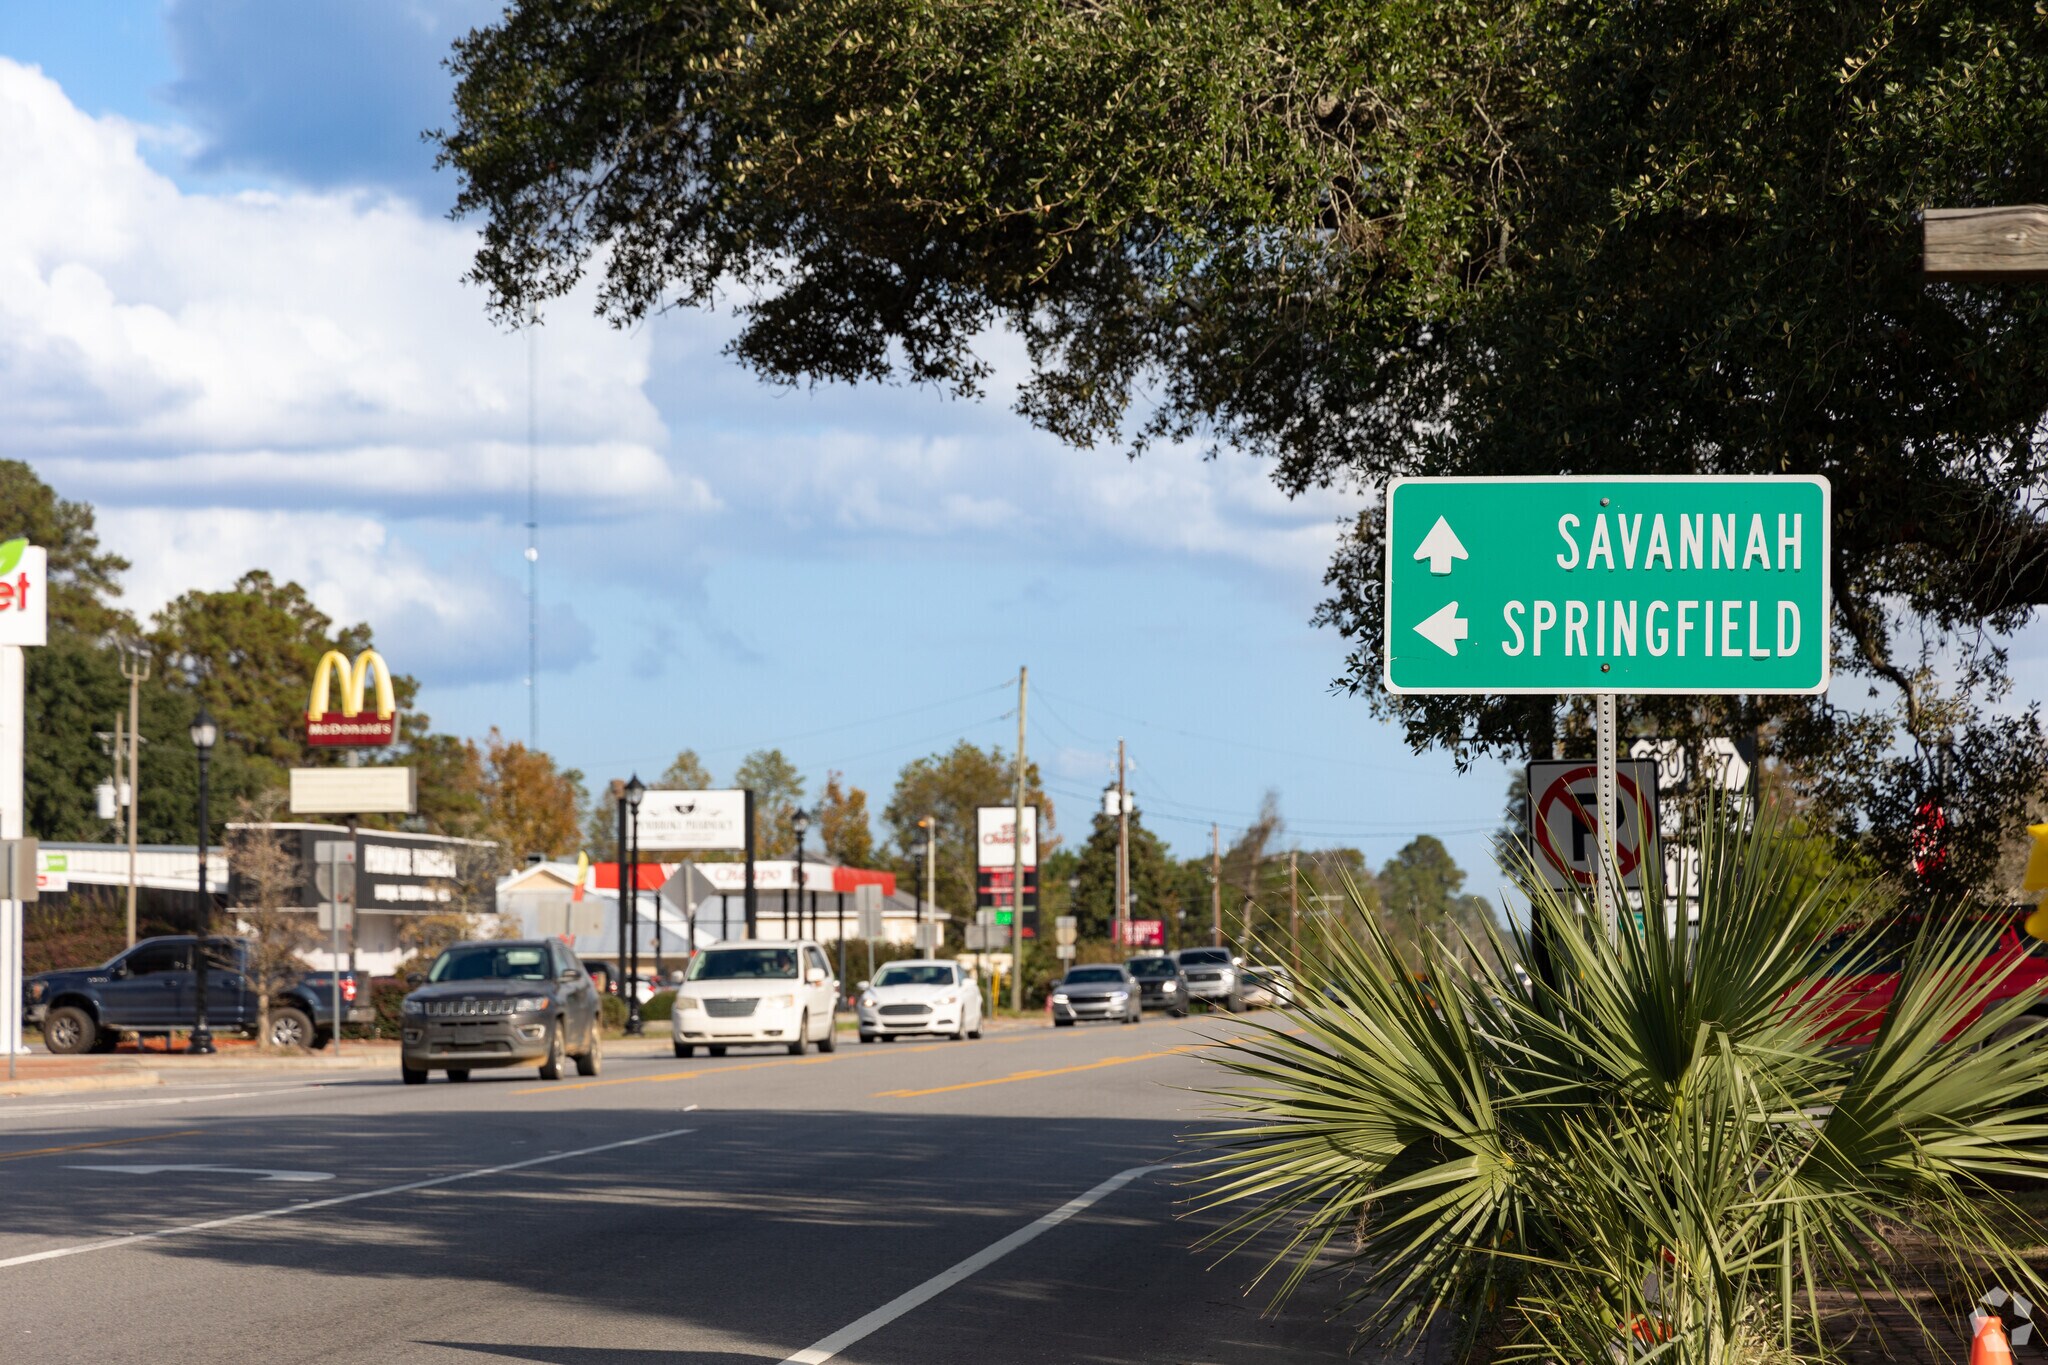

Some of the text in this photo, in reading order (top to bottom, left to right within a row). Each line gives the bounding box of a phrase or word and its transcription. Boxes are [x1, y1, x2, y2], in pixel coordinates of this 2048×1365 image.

[1556, 513, 1803, 570] SAVANNAH
[1501, 600, 1802, 656] SPRINGFIELD
[308, 722, 392, 735] McDonald's
